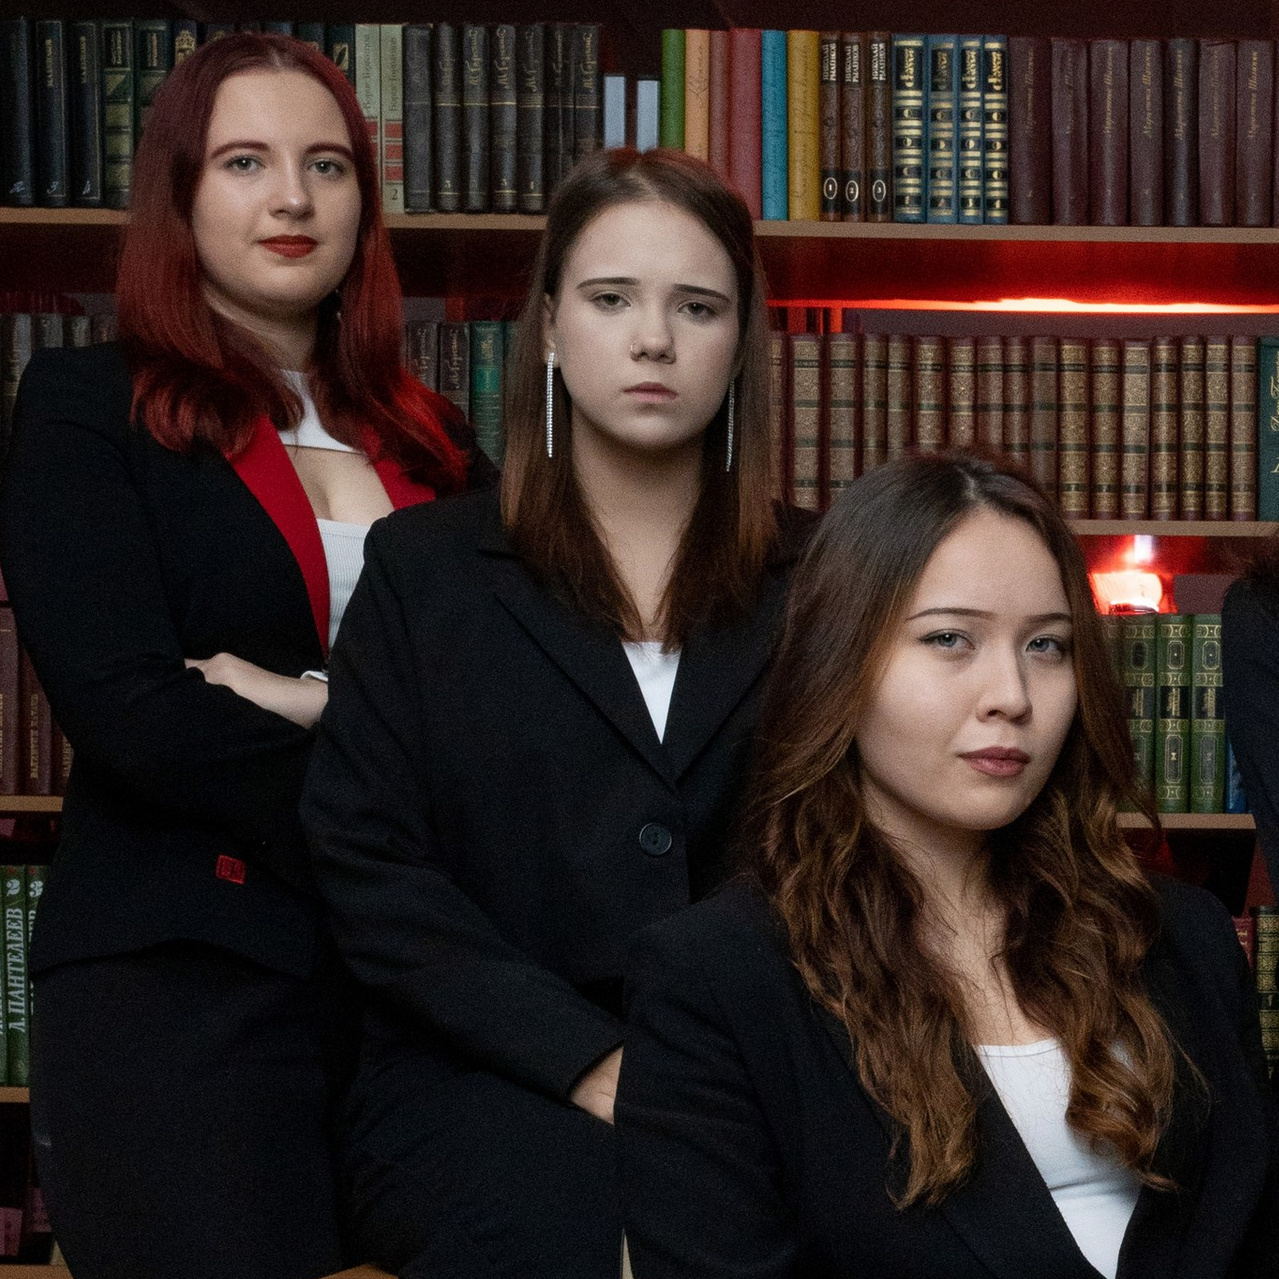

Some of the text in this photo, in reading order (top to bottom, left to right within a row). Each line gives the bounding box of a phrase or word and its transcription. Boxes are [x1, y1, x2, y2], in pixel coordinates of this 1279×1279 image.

[391, 188, 399, 200] 2
[7, 878, 21, 897] 2
[29, 880, 44, 898] 3
[6, 908, 26, 1033] Л. ПАНТЕЛЕЕВ
